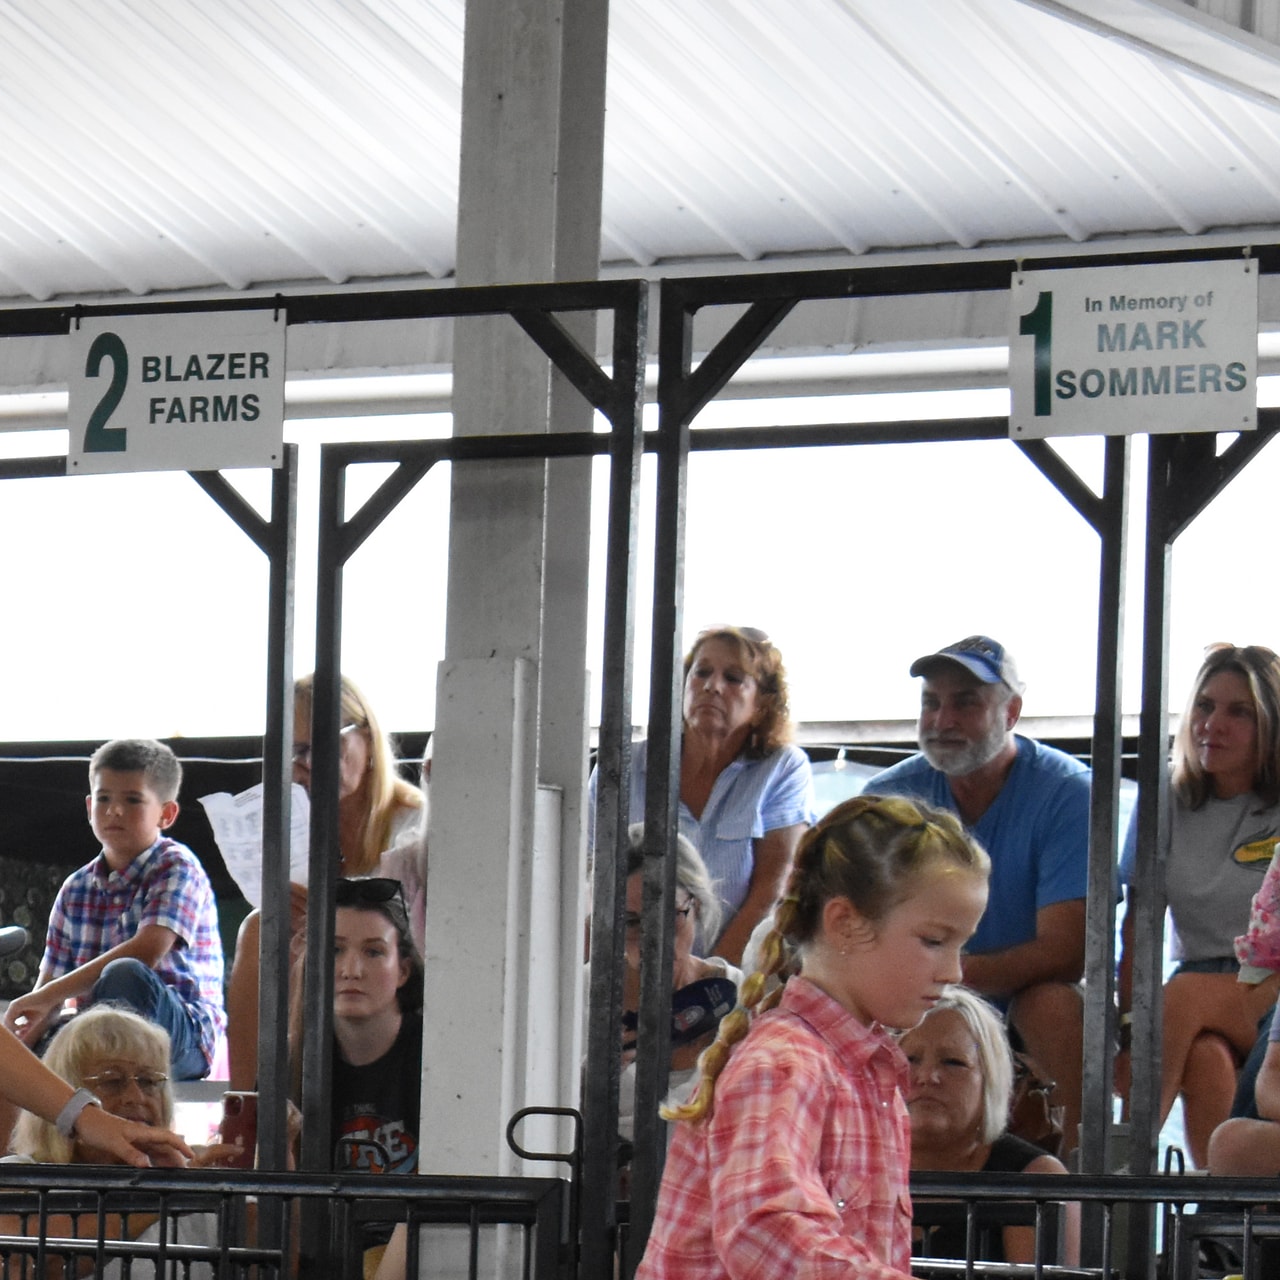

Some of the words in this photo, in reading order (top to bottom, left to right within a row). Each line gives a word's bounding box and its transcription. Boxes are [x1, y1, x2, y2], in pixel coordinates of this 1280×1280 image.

[1085, 297, 1102, 312] In
[1109, 294, 1187, 313] Memory
[1193, 291, 1214, 307] of
[1097, 318, 1207, 353] MARK
[142, 352, 270, 383] BLAZER
[1019, 291, 1052, 416] 1
[83, 332, 128, 453] 2
[1055, 361, 1247, 400] SOMMERS
[149, 393, 260, 424] FARMS
